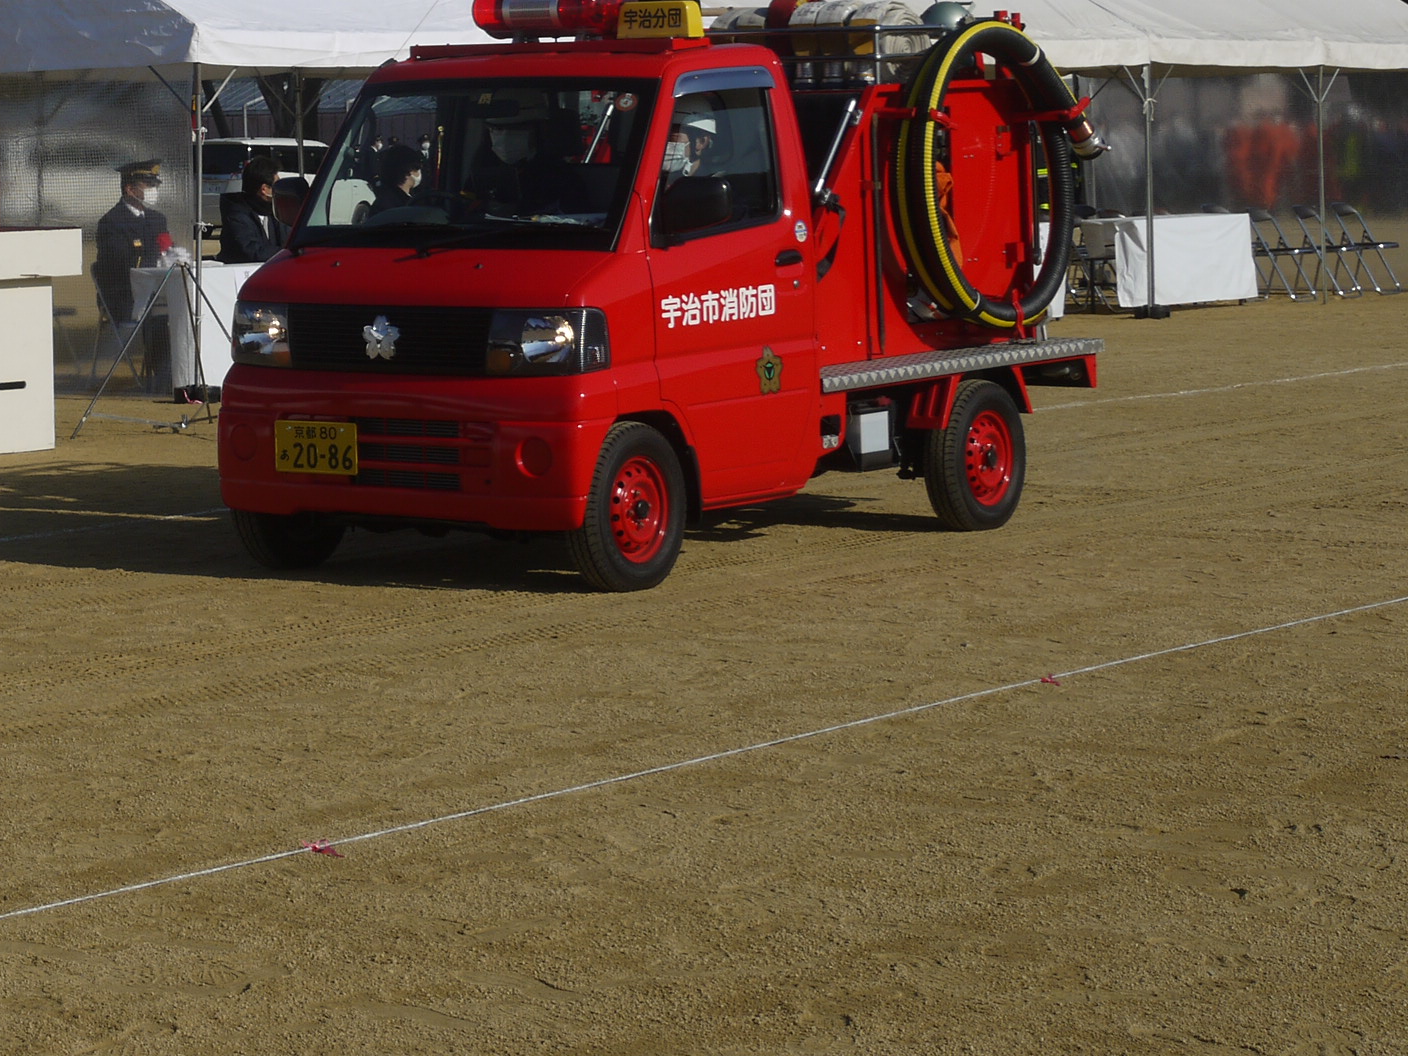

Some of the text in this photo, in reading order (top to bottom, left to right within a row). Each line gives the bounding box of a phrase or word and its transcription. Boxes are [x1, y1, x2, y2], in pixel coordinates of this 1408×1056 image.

[623, 8, 682, 30] 宇治分団
[660, 283, 776, 329] 宇治市消防団
[293, 425, 337, 440] 京都 80
[279, 442, 353, 471] あ 20-86
